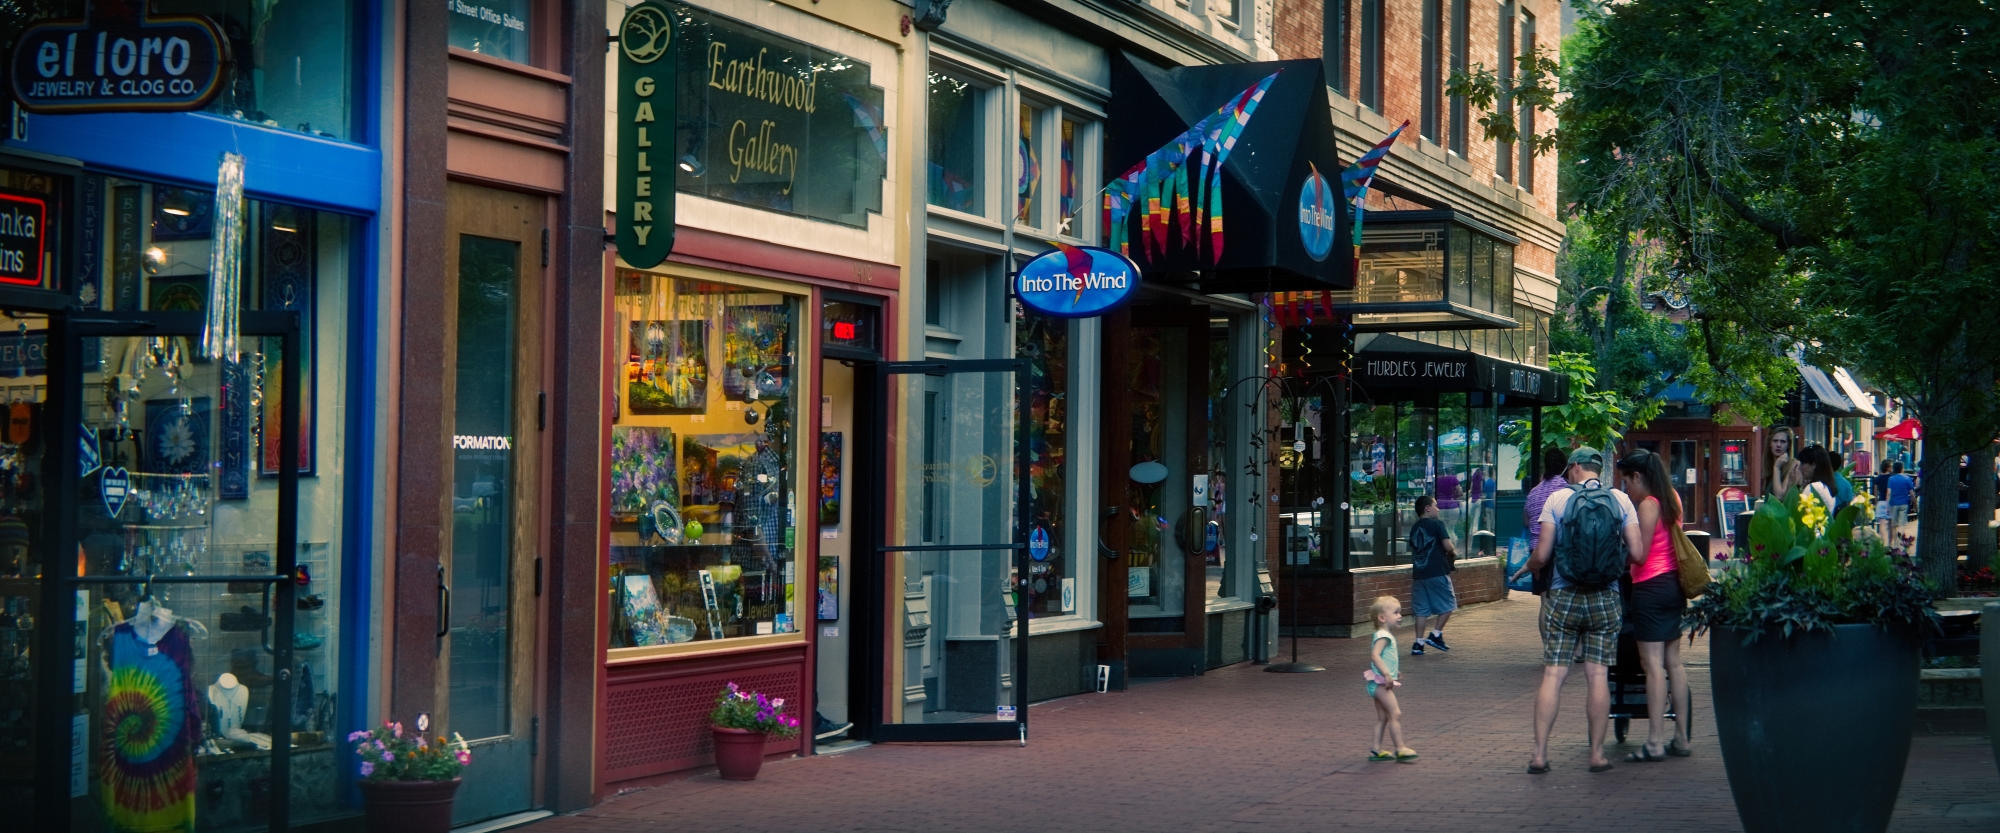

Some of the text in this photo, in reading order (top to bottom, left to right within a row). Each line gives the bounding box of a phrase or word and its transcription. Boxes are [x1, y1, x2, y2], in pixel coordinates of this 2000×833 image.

[456, 0, 478, 18] Street
[480, 7, 501, 24] Office
[503, 13, 524, 31] Suites
[37, 31, 190, 78] el loro
[29, 78, 198, 97] JEWELRY & CLOG CO.
[708, 41, 820, 114] Earthwood
[633, 77, 656, 246] GALLERY
[729, 120, 797, 195] Gallery
[0, 206, 36, 238] nka
[82, 177, 98, 280] SERENITY
[1300, 202, 1333, 230] Into The Wind
[121, 197, 133, 299] BREATHE
[1022, 271, 1126, 292] Into The Wind
[1368, 360, 1467, 377] HURDLE'S JEWELRY
[453, 435, 511, 450] FORMATION
